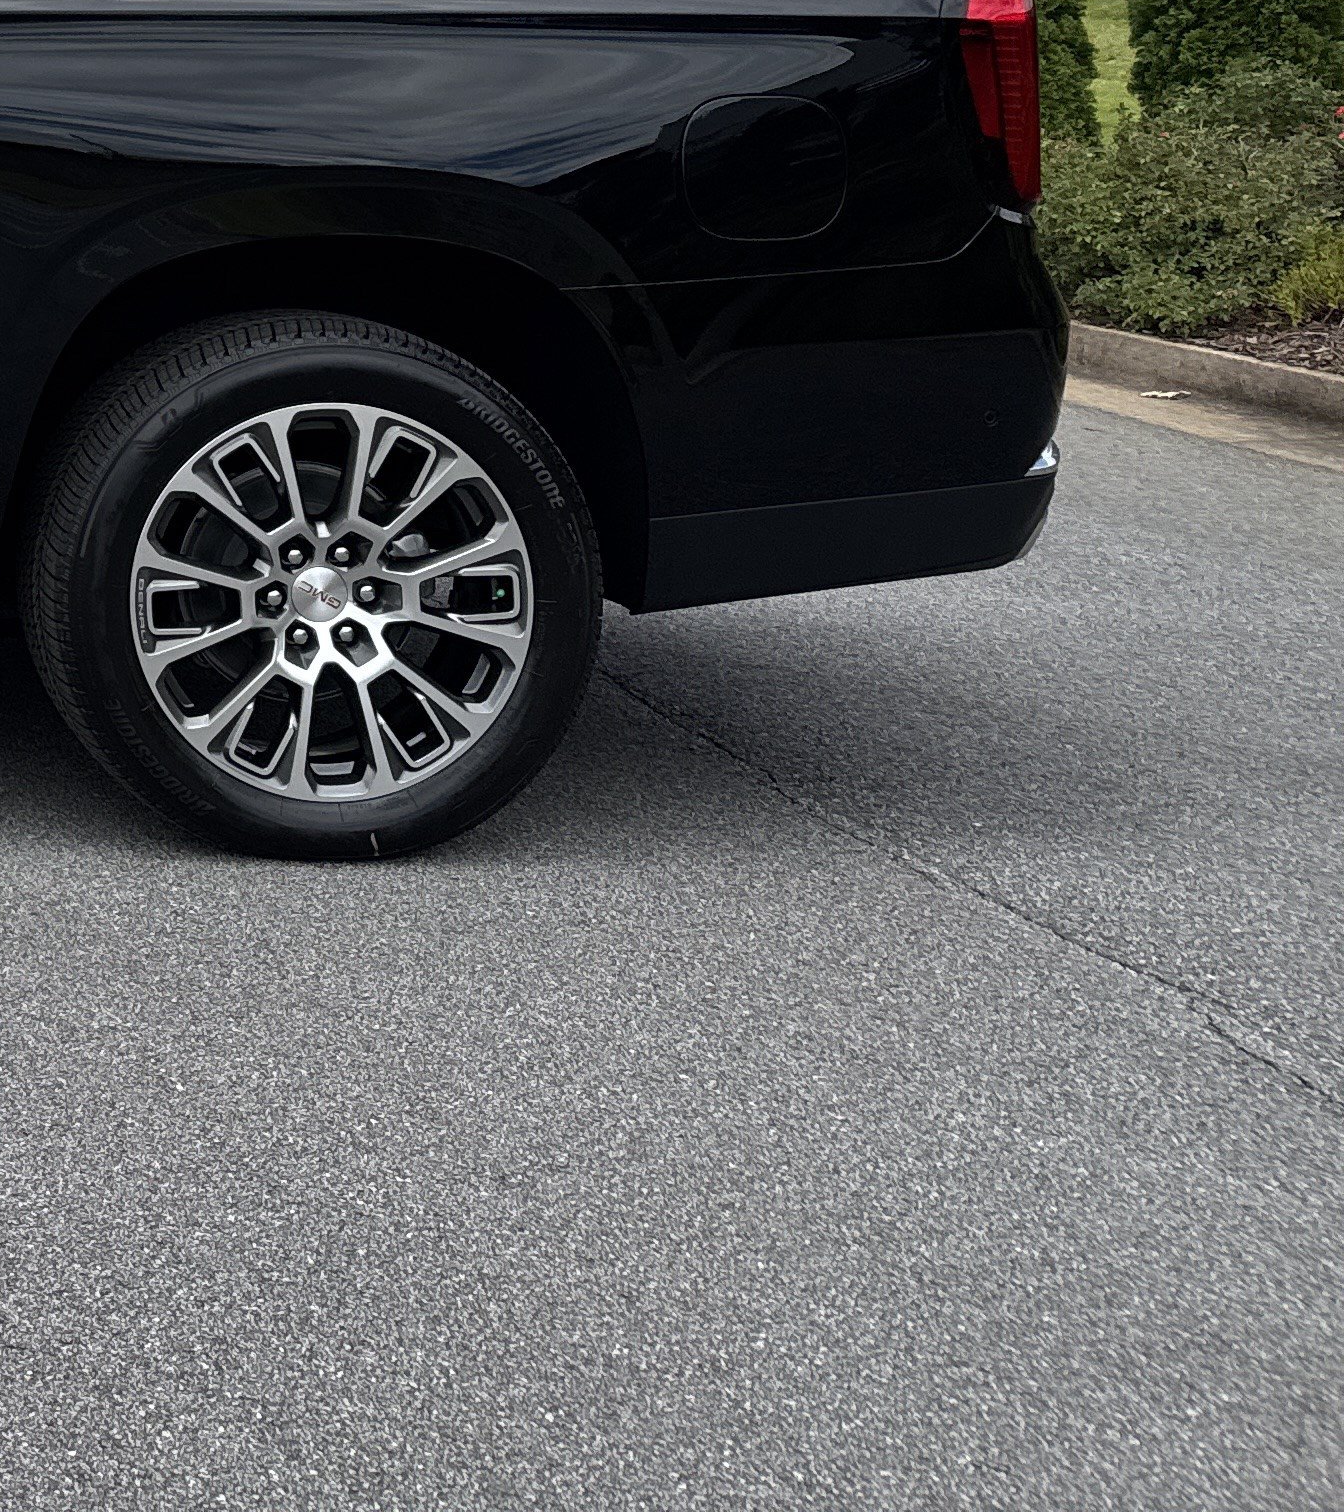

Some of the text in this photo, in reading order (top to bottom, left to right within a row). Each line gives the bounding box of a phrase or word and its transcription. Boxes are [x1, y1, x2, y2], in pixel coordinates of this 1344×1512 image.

[456, 397, 566, 511] BRIDGESTONE
[137, 578, 148, 644] DENALI
[297, 580, 342, 609] GMC
